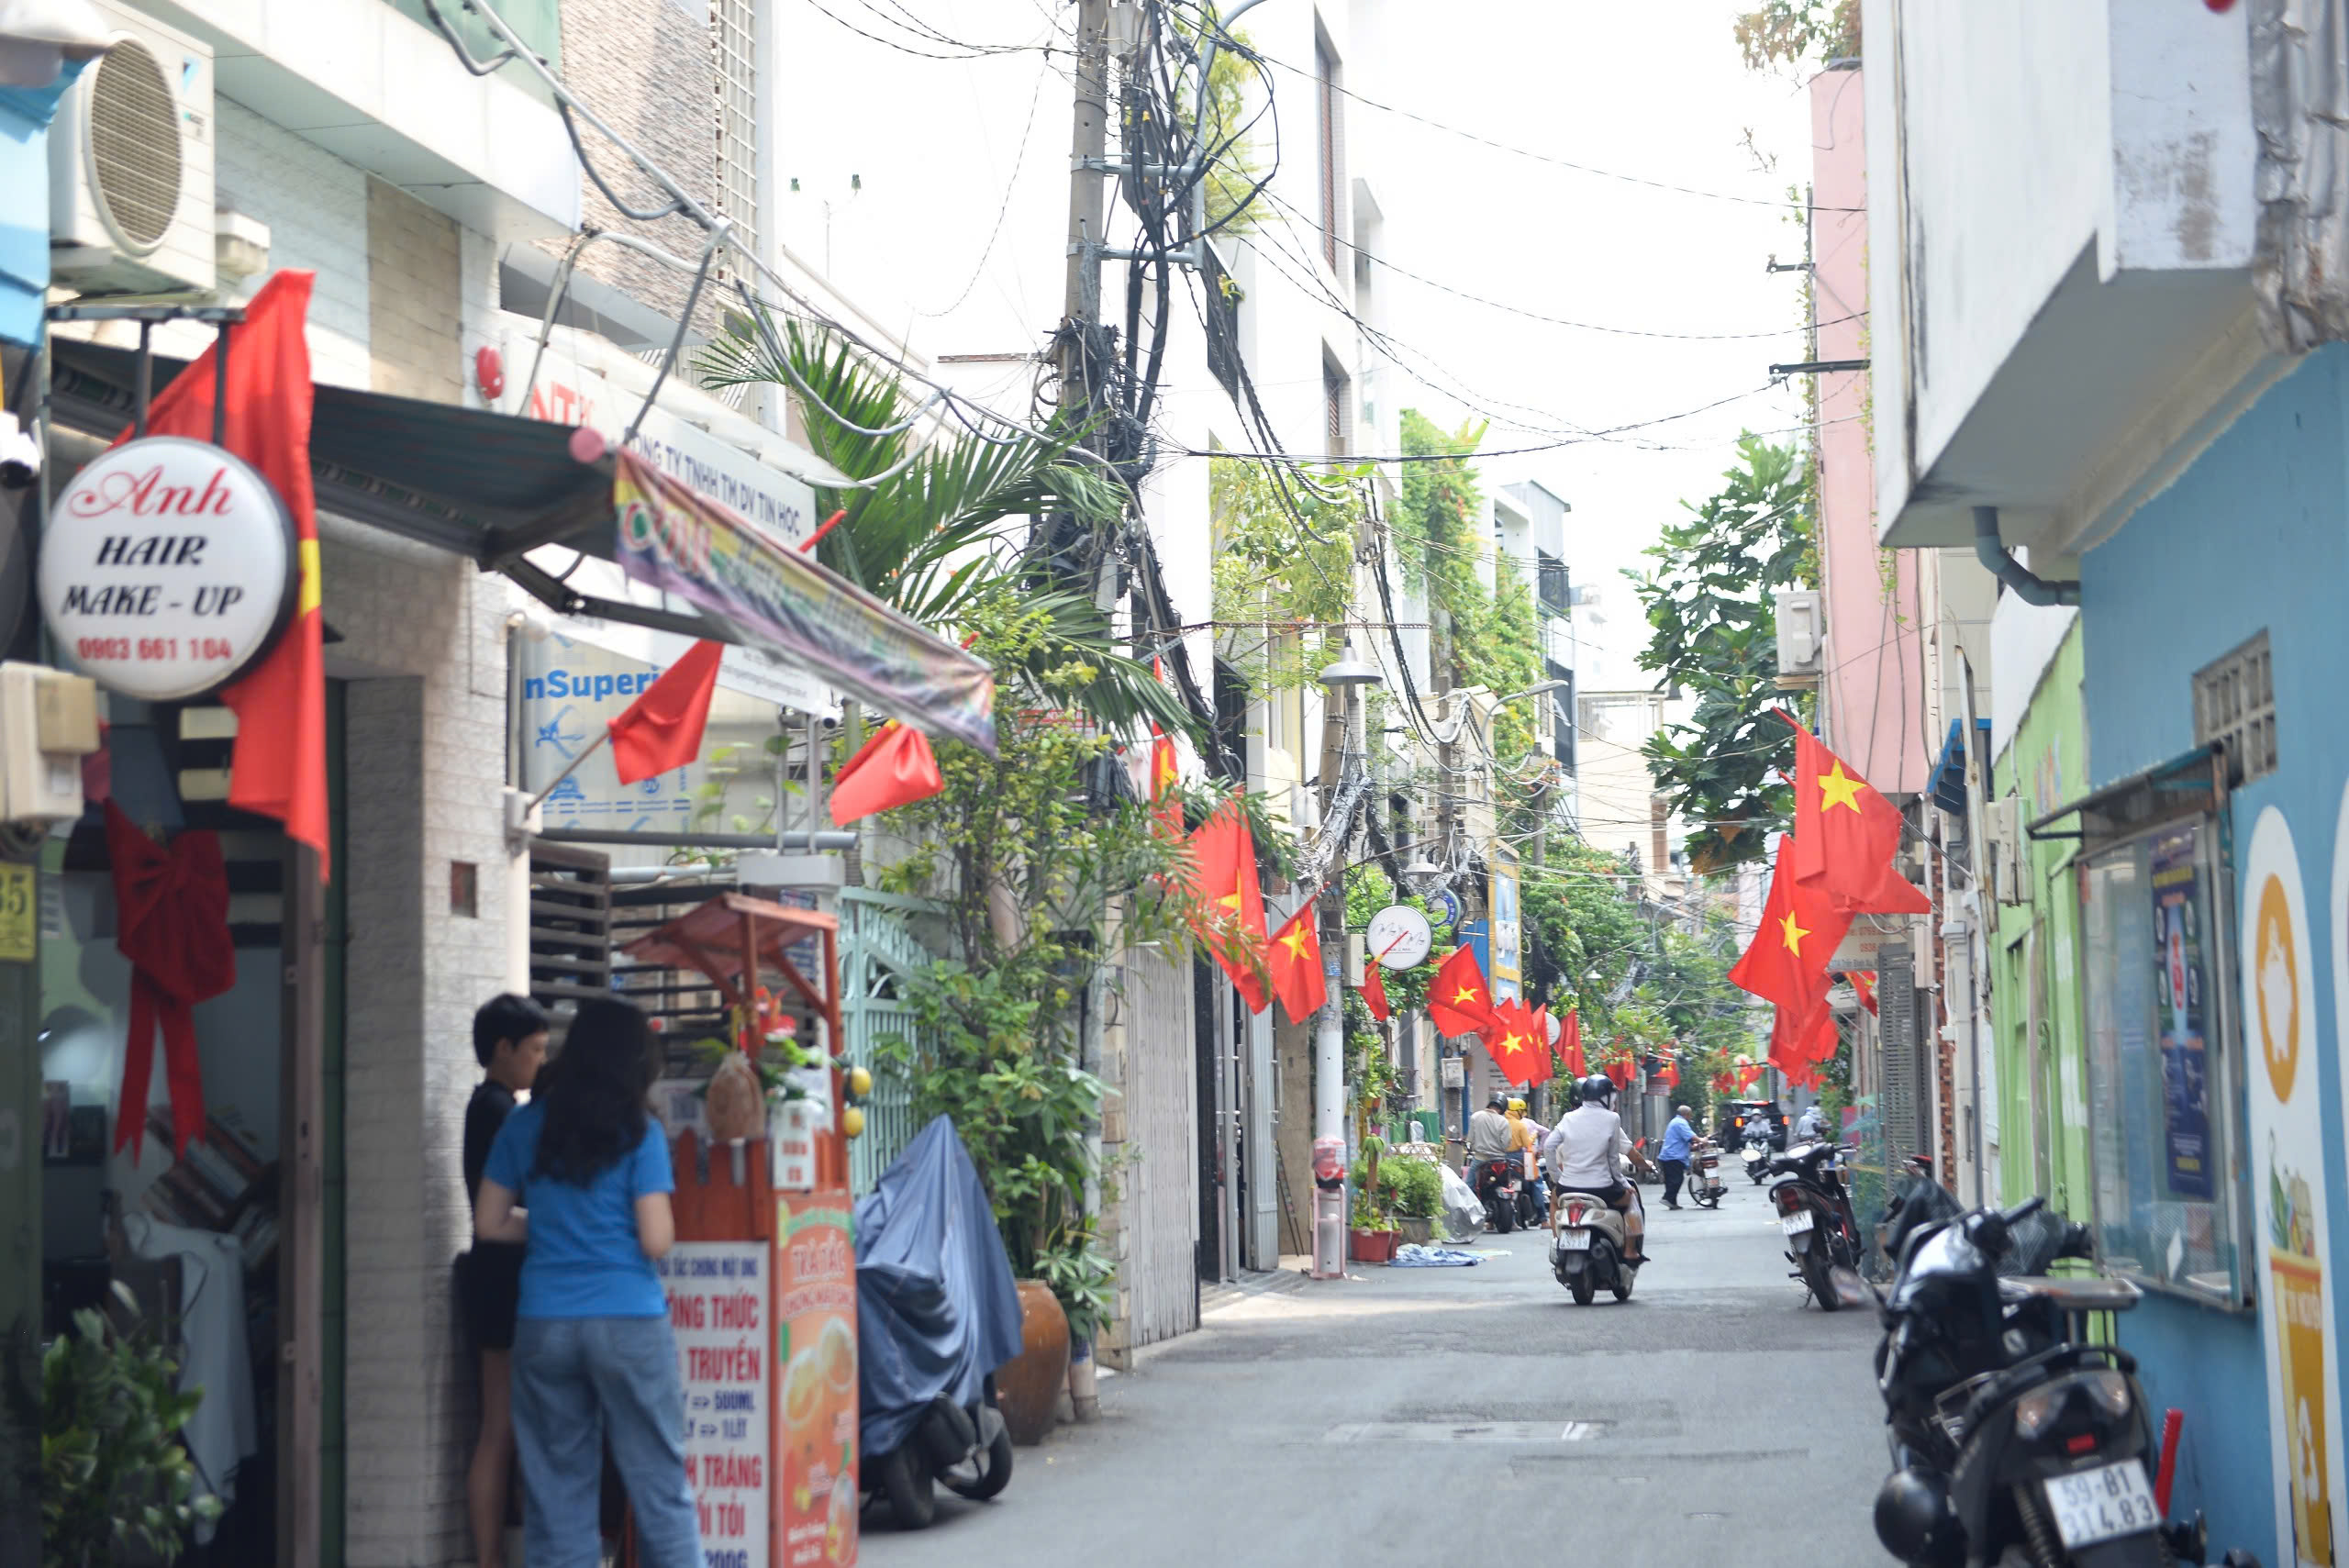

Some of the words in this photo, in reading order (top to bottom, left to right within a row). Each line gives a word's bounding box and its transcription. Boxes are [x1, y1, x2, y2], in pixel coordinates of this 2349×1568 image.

[68, 463, 233, 518] Anh
[665, 445, 683, 479] TY
[685, 455, 718, 496] TNHH
[740, 484, 756, 515] DV
[758, 492, 776, 525] TIN
[96, 535, 207, 566] HAIR
[61, 585, 161, 617] MAKE
[192, 585, 244, 617] UP
[139, 638, 177, 661] 661
[711, 1286, 759, 1329] THỨC
[703, 1446, 763, 1488] TRÁNG
